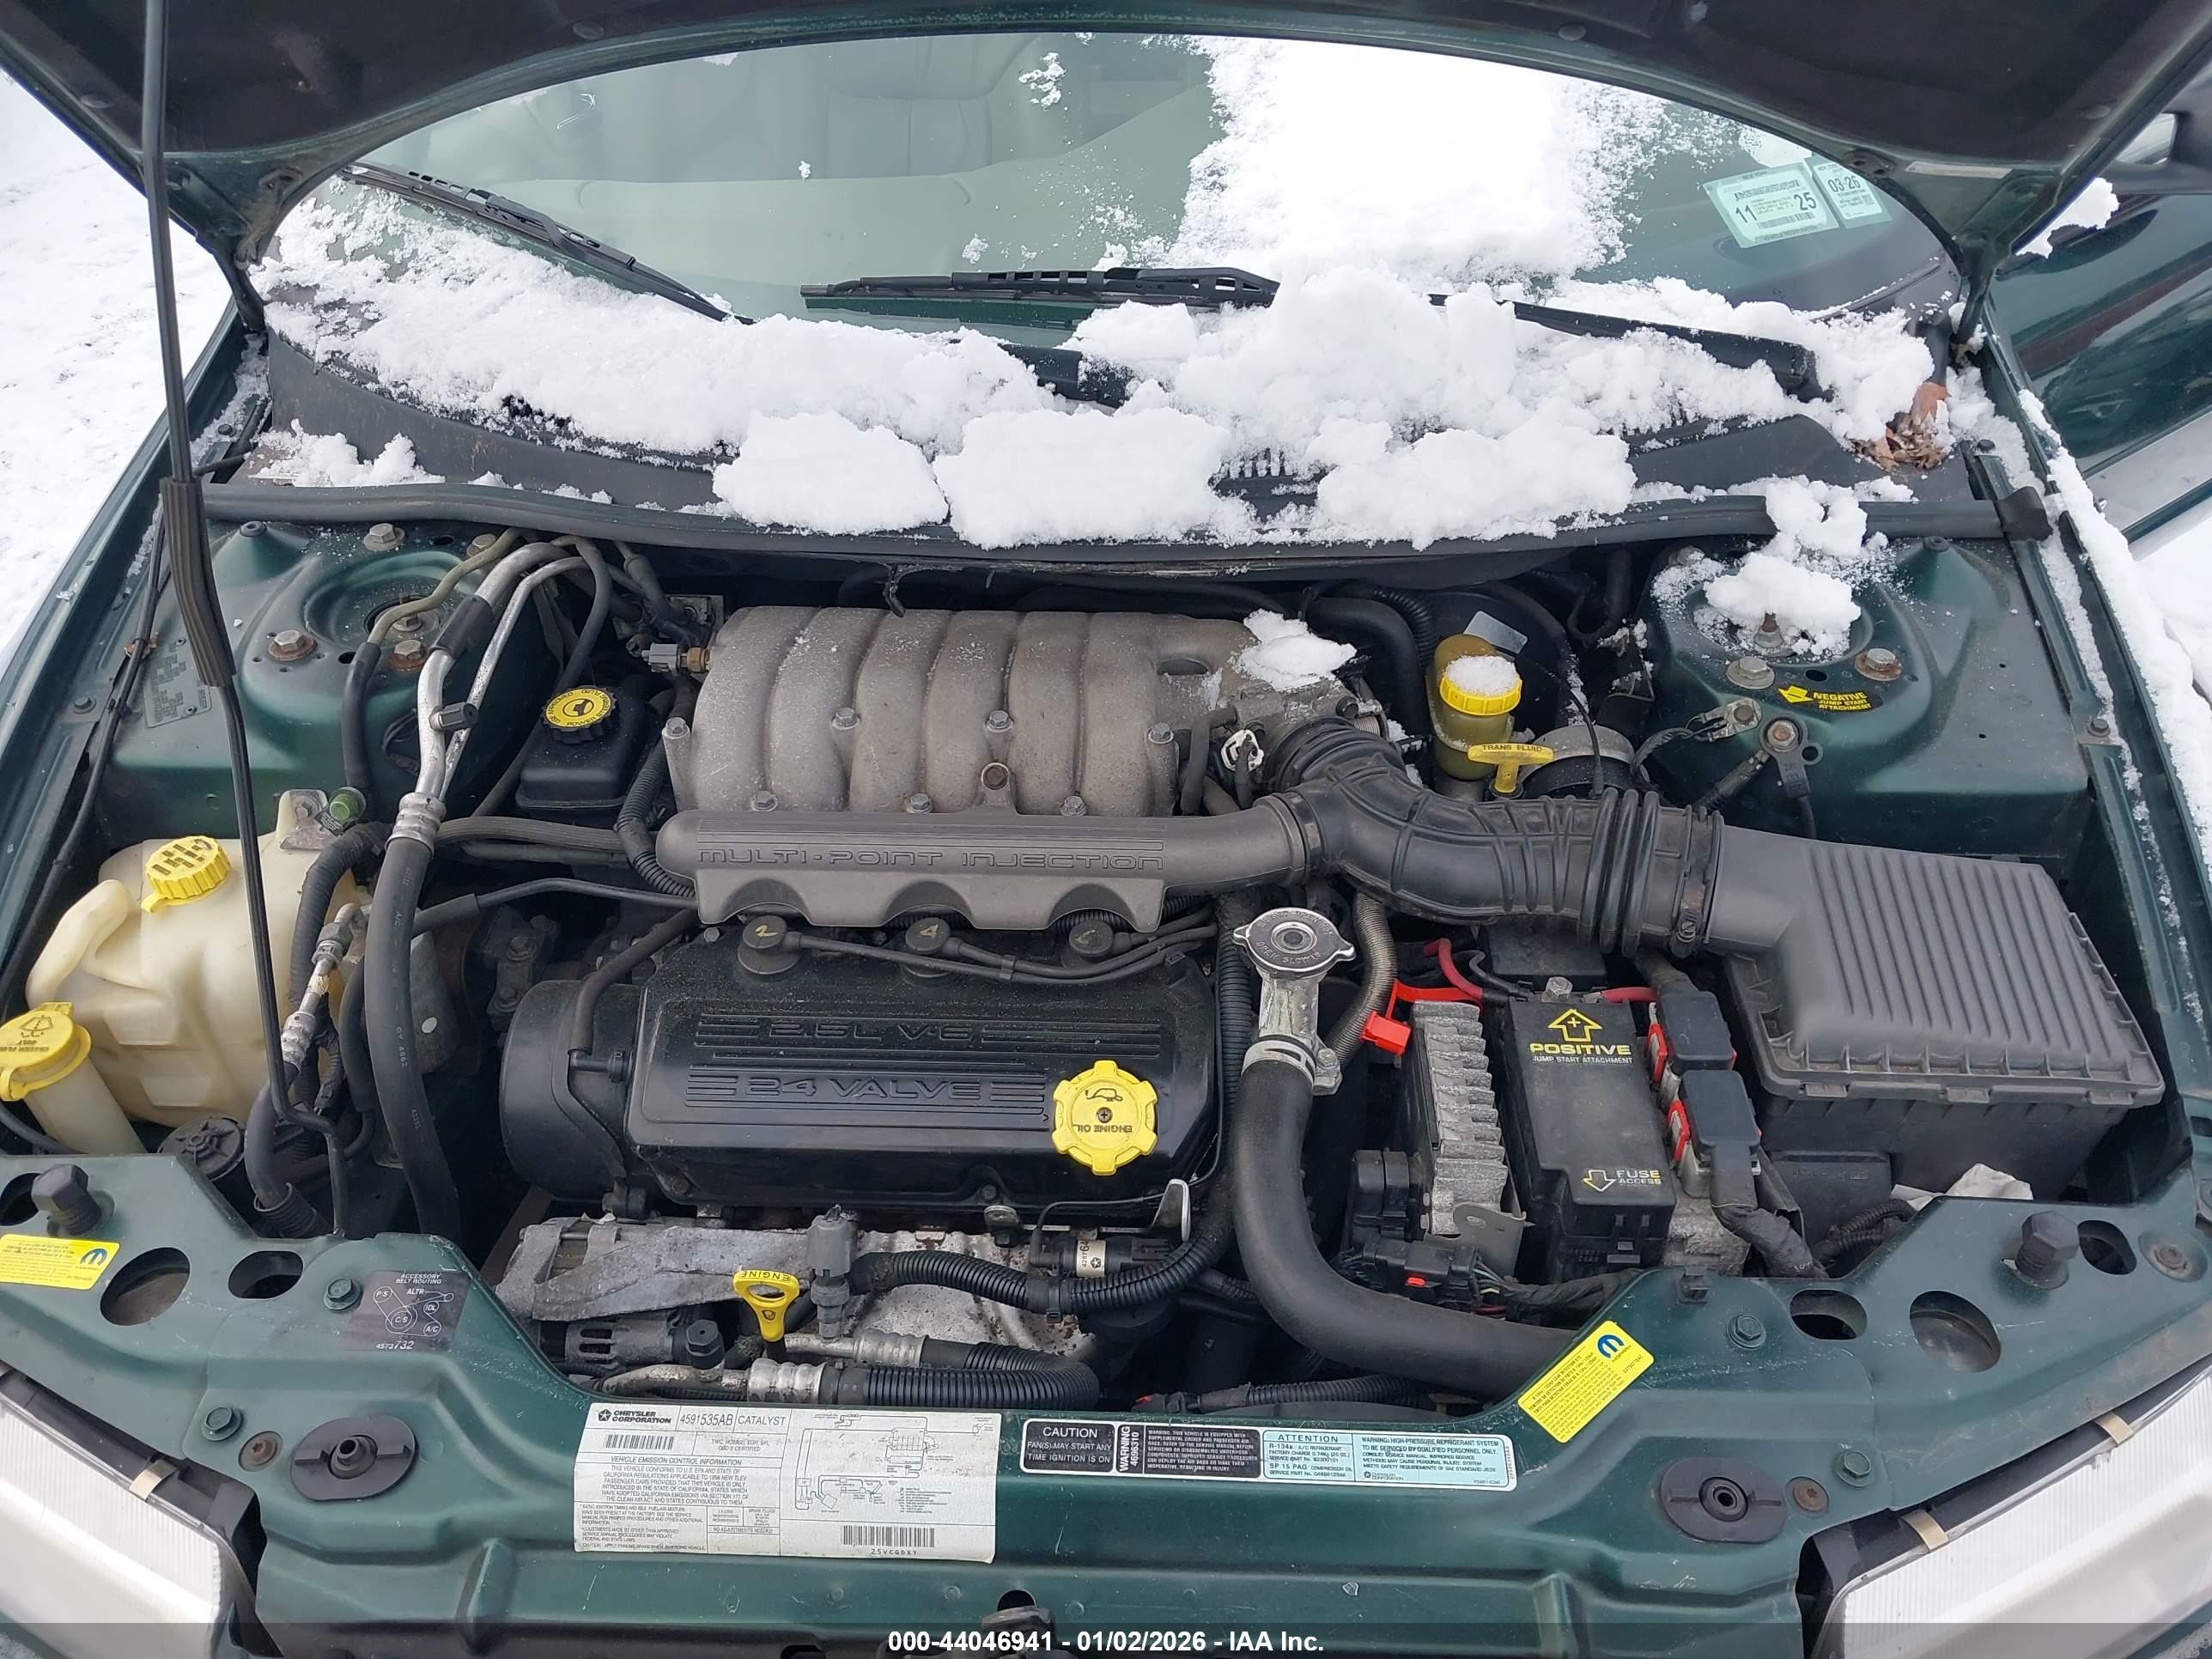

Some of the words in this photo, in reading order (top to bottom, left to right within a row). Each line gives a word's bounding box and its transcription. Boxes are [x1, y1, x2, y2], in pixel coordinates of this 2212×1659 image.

[1827, 178, 1844, 192] 03
[1844, 175, 1861, 190] 26
[1794, 191, 1817, 210] 25
[1735, 204, 1758, 223] 11
[1813, 692, 1868, 701] NEGATIVE
[962, 852, 1163, 870] INJECTION
[1529, 1043, 1632, 1055] POSITIVE
[1583, 1056, 1633, 1065] ATTACHMENT
[747, 1078, 817, 1097] 24
[828, 1078, 981, 1099] VALVE
[1074, 1124, 1091, 1133] OIL
[1093, 1124, 1133, 1133] ENGINE
[1616, 1170, 1660, 1178] FUSE
[738, 1271, 790, 1282] ENGINE
[375, 1340, 414, 1349] 4573732
[680, 1413, 733, 1425] 4591535AB
[738, 1415, 786, 1425] CATALYST
[1043, 1427, 1097, 1438] CAUTION
[1120, 1426, 1131, 1472] WARNING
[1130, 1431, 1139, 1466] 4696310
